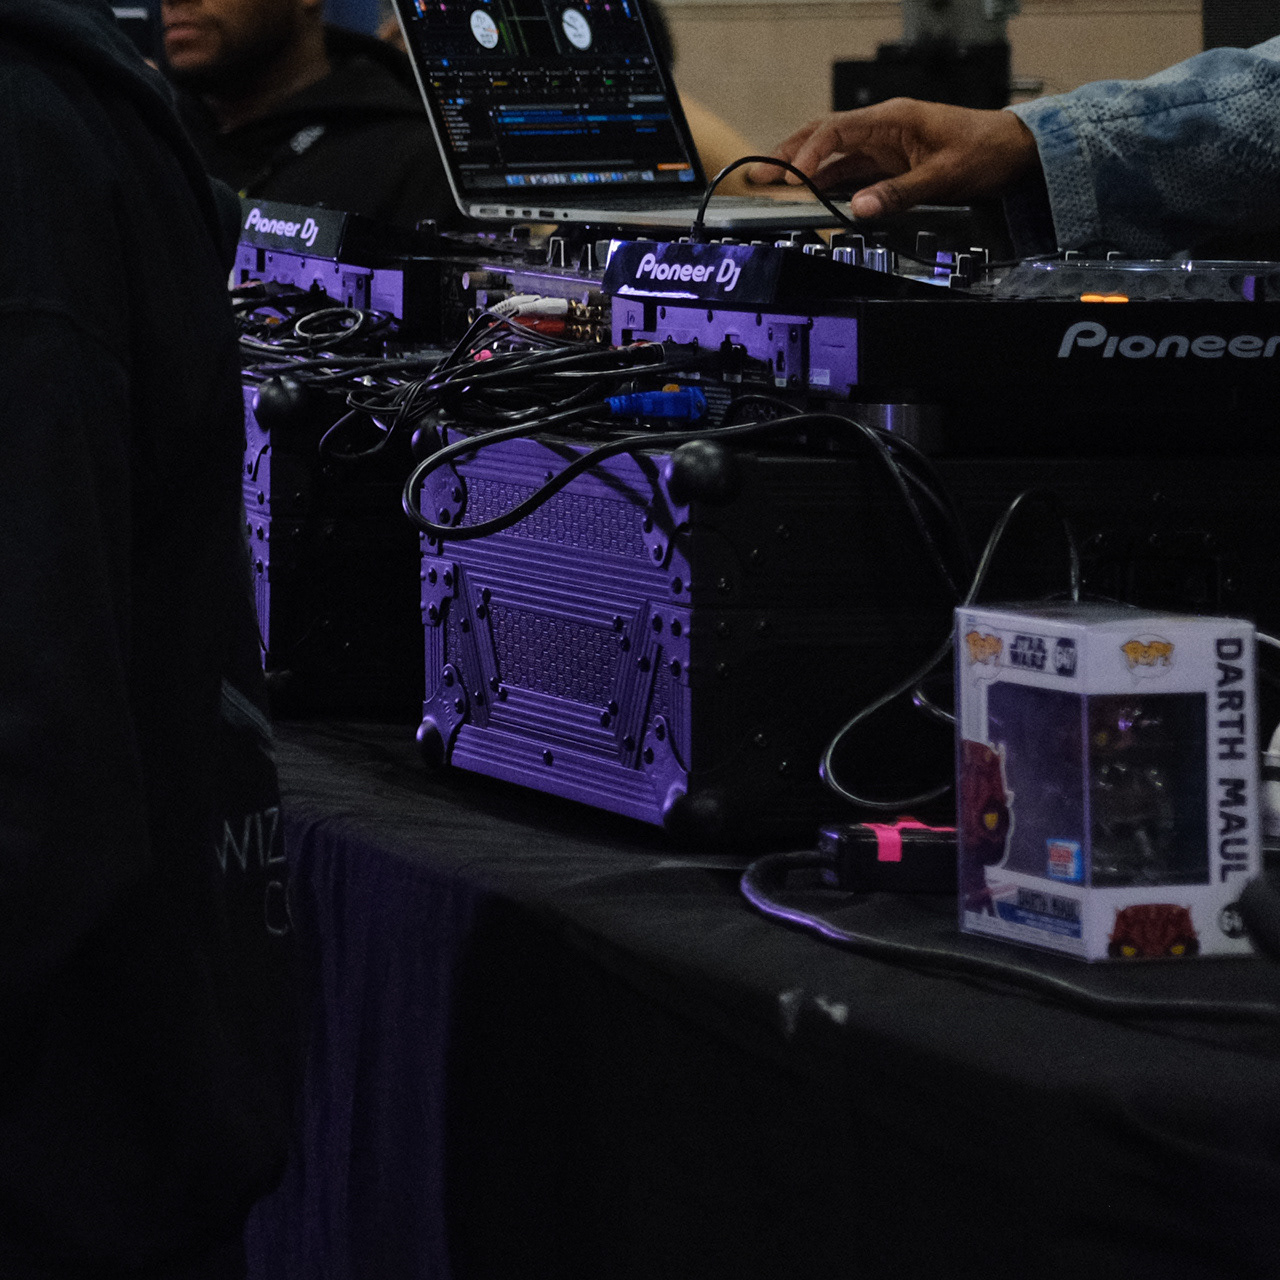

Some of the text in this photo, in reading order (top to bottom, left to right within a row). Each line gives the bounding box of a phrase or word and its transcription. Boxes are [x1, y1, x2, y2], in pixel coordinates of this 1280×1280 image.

[244, 207, 301, 237] Pioneer
[635, 253, 715, 282] Pioneer
[1215, 637, 1247, 760] DARTH
[1217, 777, 1251, 883] MAUL
